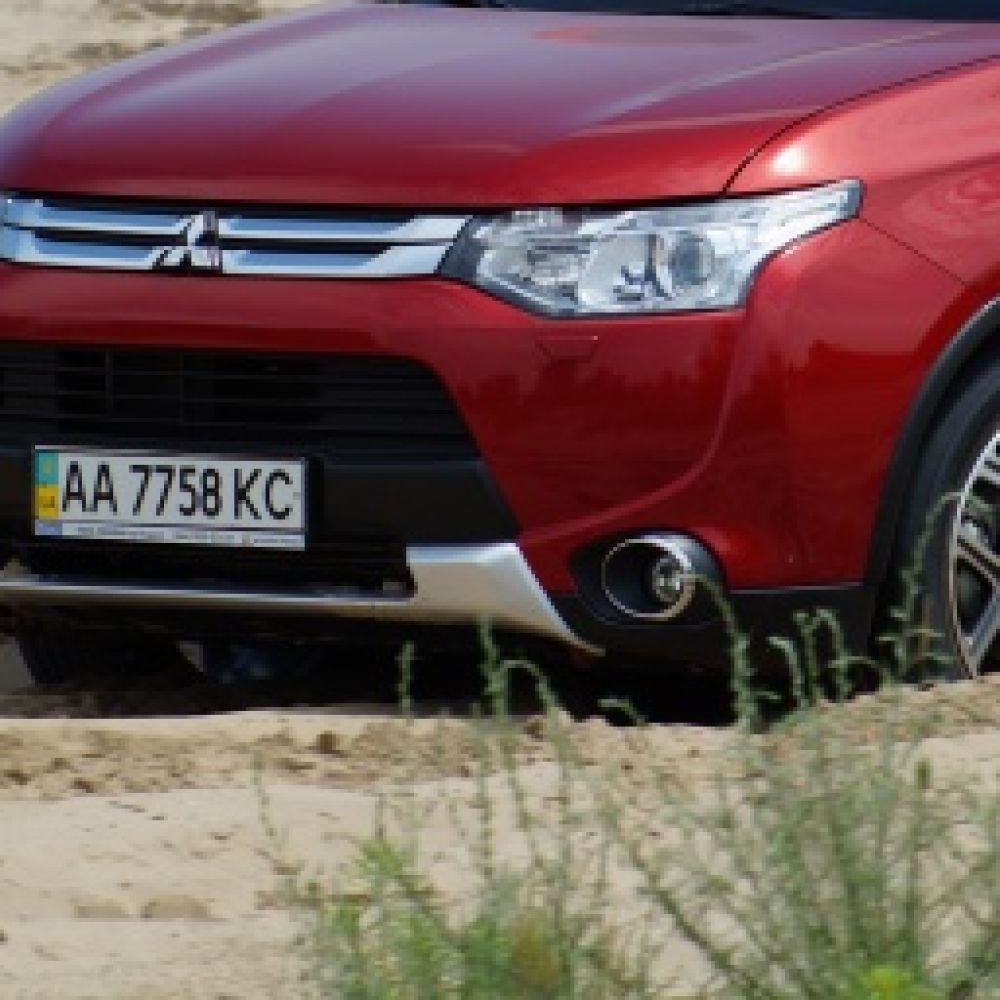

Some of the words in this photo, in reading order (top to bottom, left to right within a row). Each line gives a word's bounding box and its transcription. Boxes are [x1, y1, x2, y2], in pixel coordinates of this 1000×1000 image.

[62, 460, 118, 514] AA
[128, 464, 222, 517] 7758
[233, 468, 294, 520] KC
